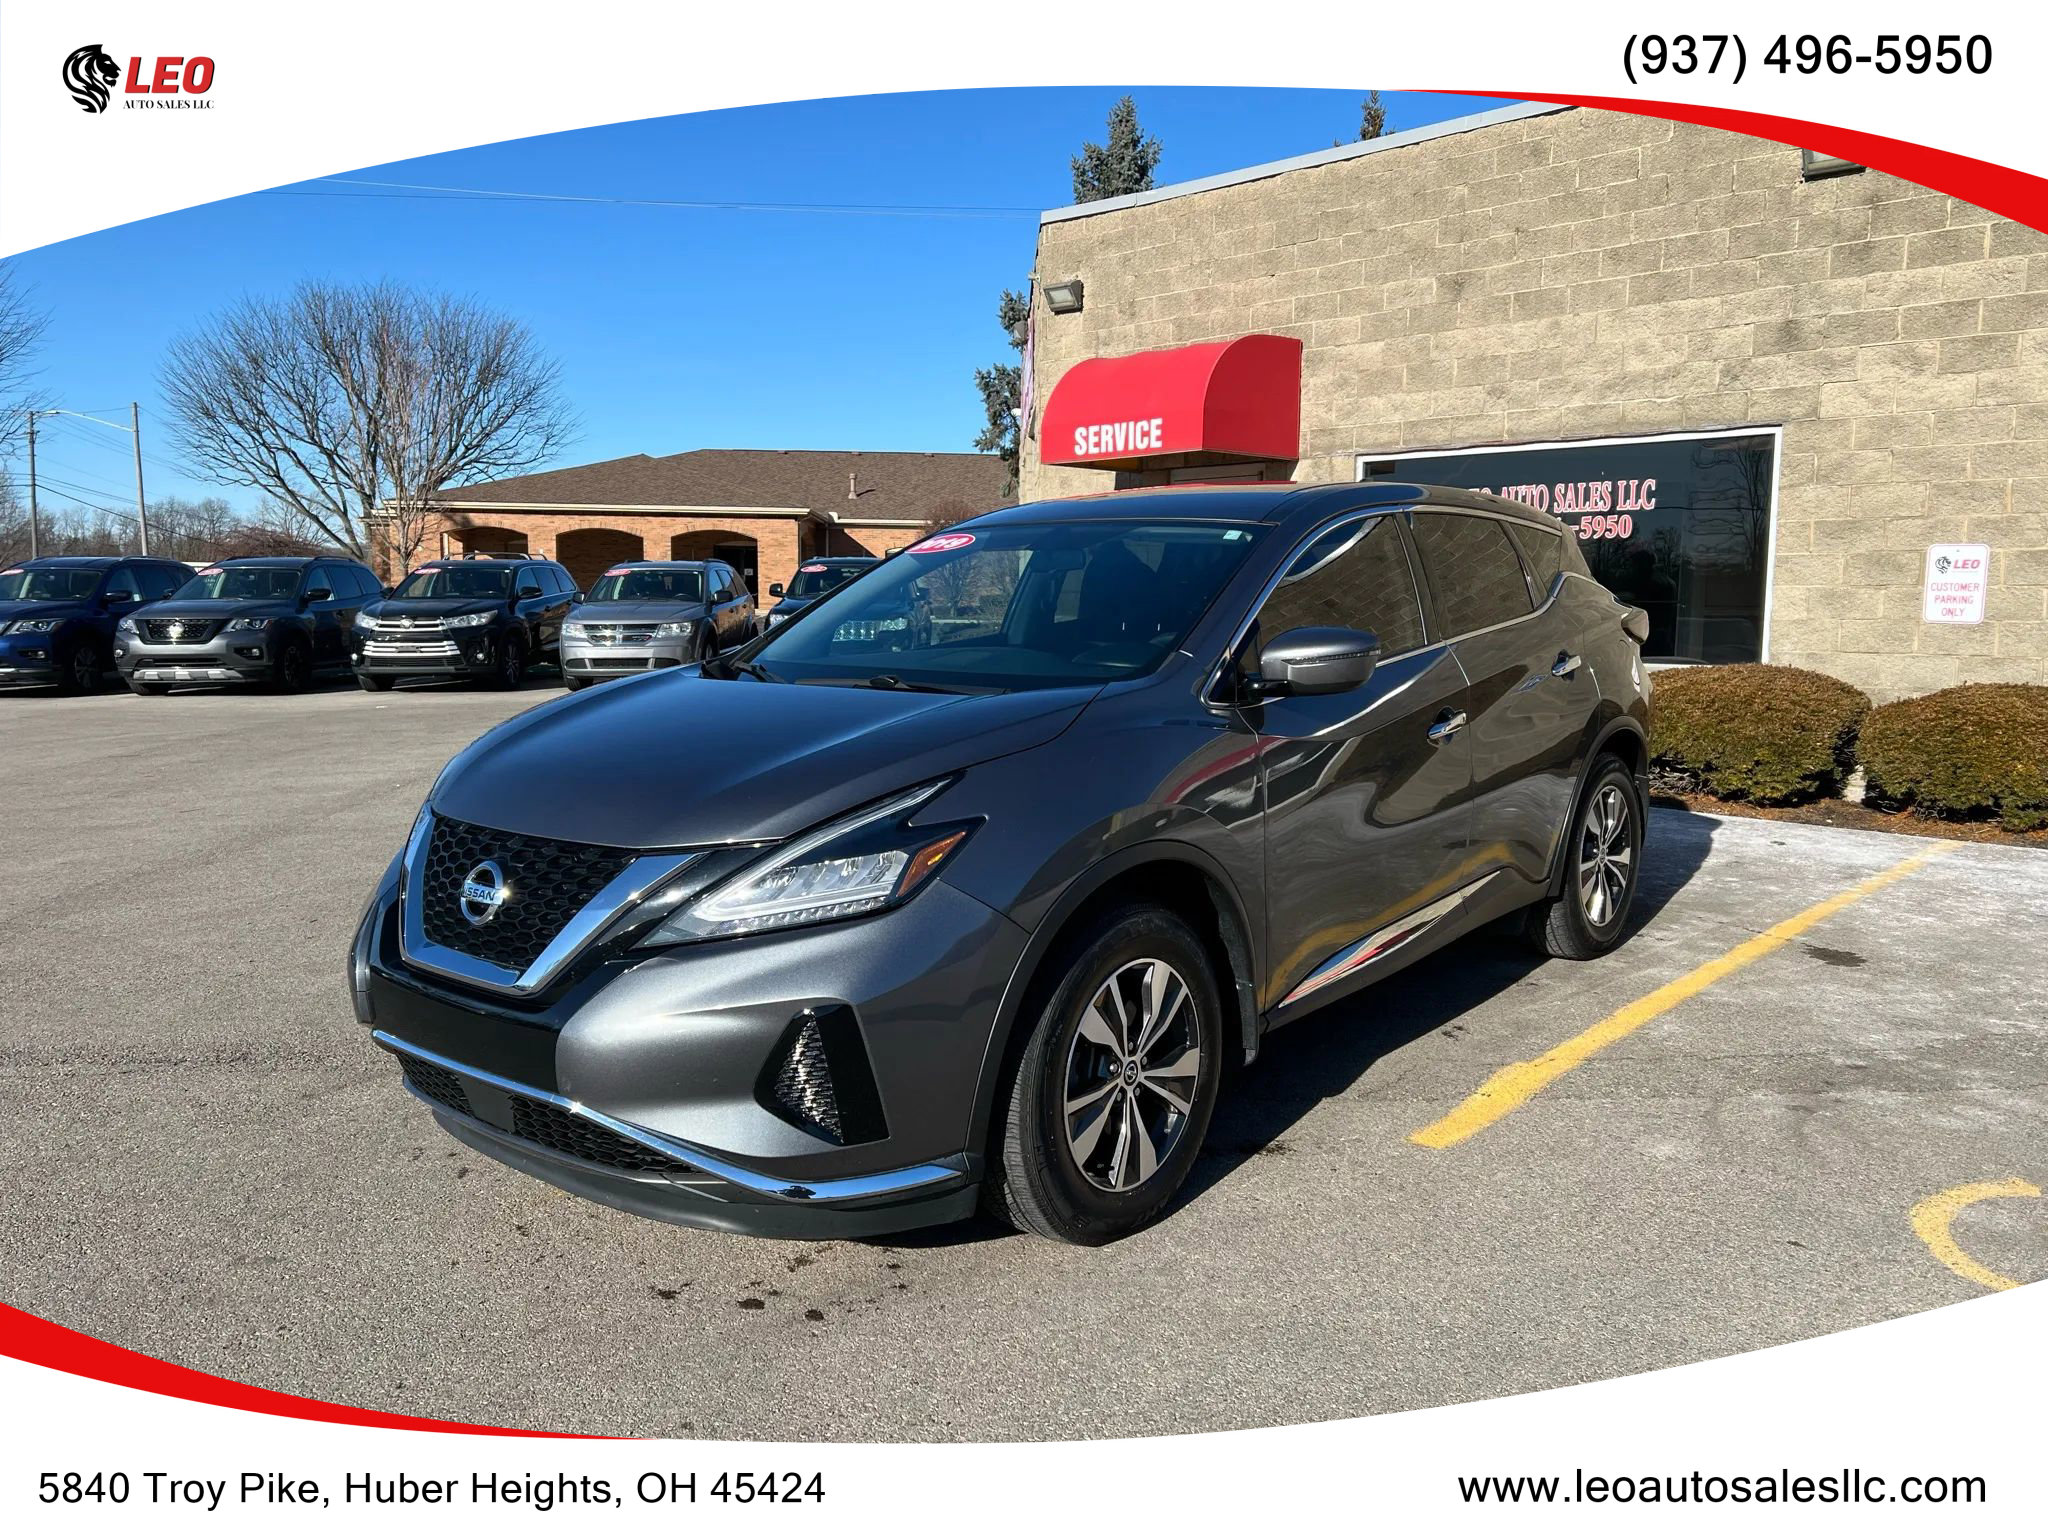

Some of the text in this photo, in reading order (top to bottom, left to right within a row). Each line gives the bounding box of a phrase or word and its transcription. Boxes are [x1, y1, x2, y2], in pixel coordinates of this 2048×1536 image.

[1074, 418, 1163, 456] SERVICE
[1553, 481, 1612, 514] SALES
[1616, 478, 1656, 511] LLC
[1566, 514, 1633, 540] -5950
[1953, 559, 1981, 569] LEO
[1930, 582, 1980, 592] CUSTOMER
[1934, 594, 1974, 604] PARKING
[1941, 607, 1965, 617] ONLY
[465, 886, 496, 902] SSAN
